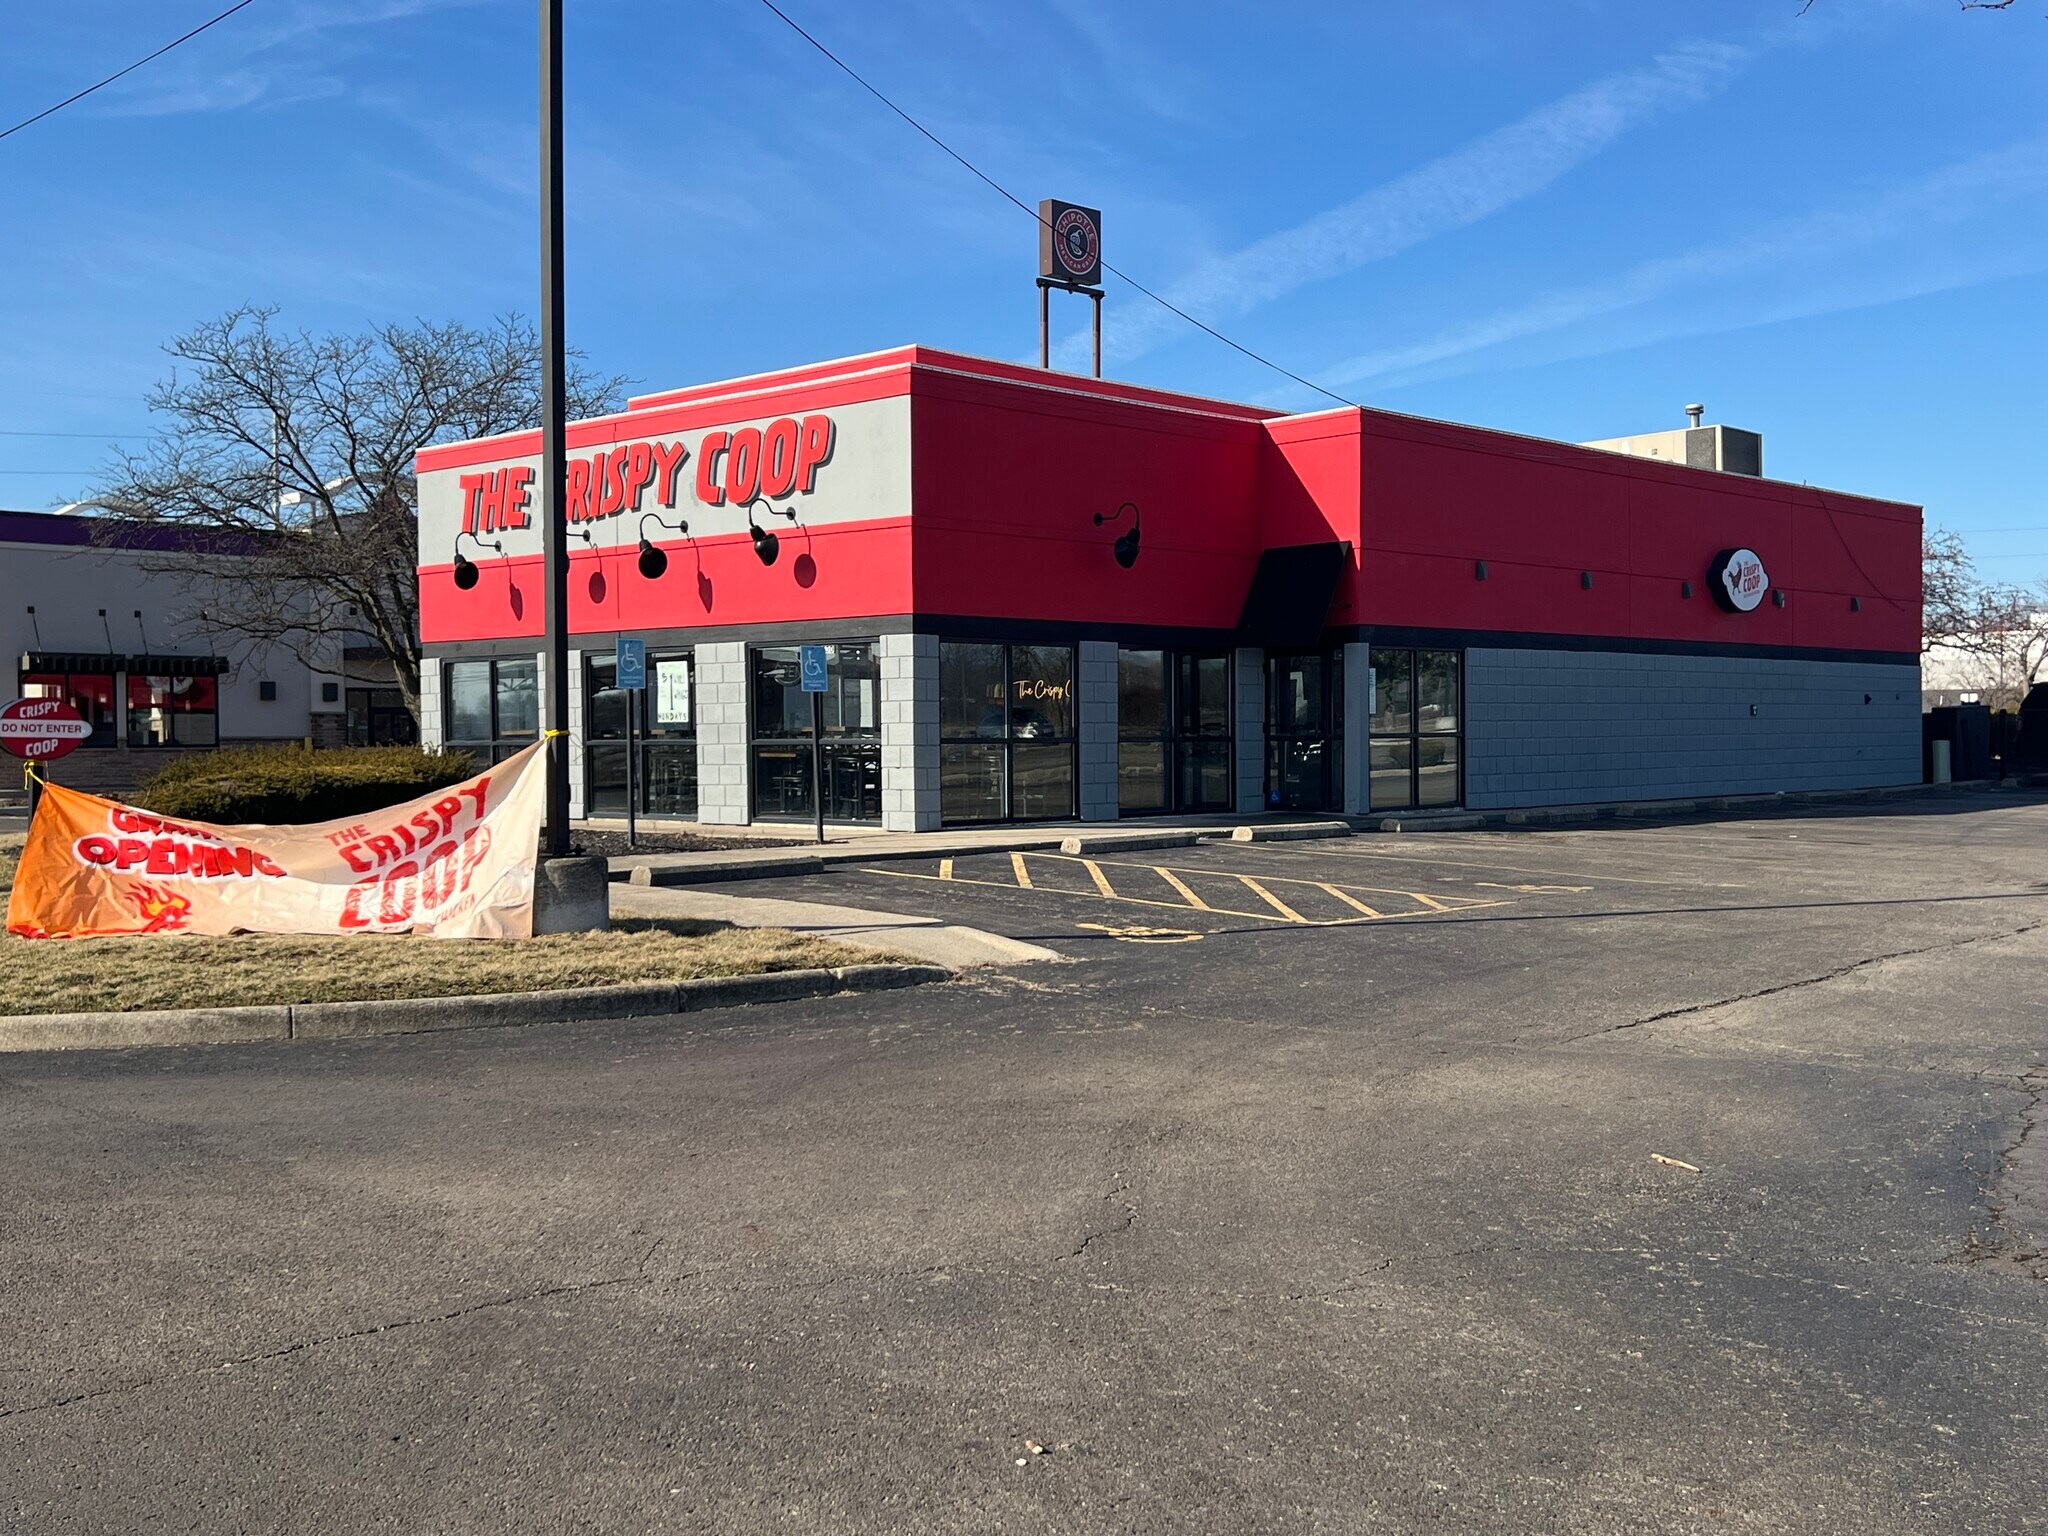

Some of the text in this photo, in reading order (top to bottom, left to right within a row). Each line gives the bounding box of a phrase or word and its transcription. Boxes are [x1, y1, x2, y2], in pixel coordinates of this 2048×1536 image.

[1058, 213, 1096, 241] CHIPOTLE
[460, 414, 836, 533] THE RISPY COOP
[1743, 574, 1760, 592] COOP
[1013, 680, 1033, 699] The
[1034, 680, 1063, 700] Crispy
[20, 701, 60, 718] CRISPY
[2, 723, 82, 733] DO NOT ENTER
[26, 739, 58, 756] COOP
[324, 824, 371, 847] THE
[339, 777, 492, 873] CRISPY
[78, 838, 287, 878] OPENING
[338, 824, 492, 928] COOP
